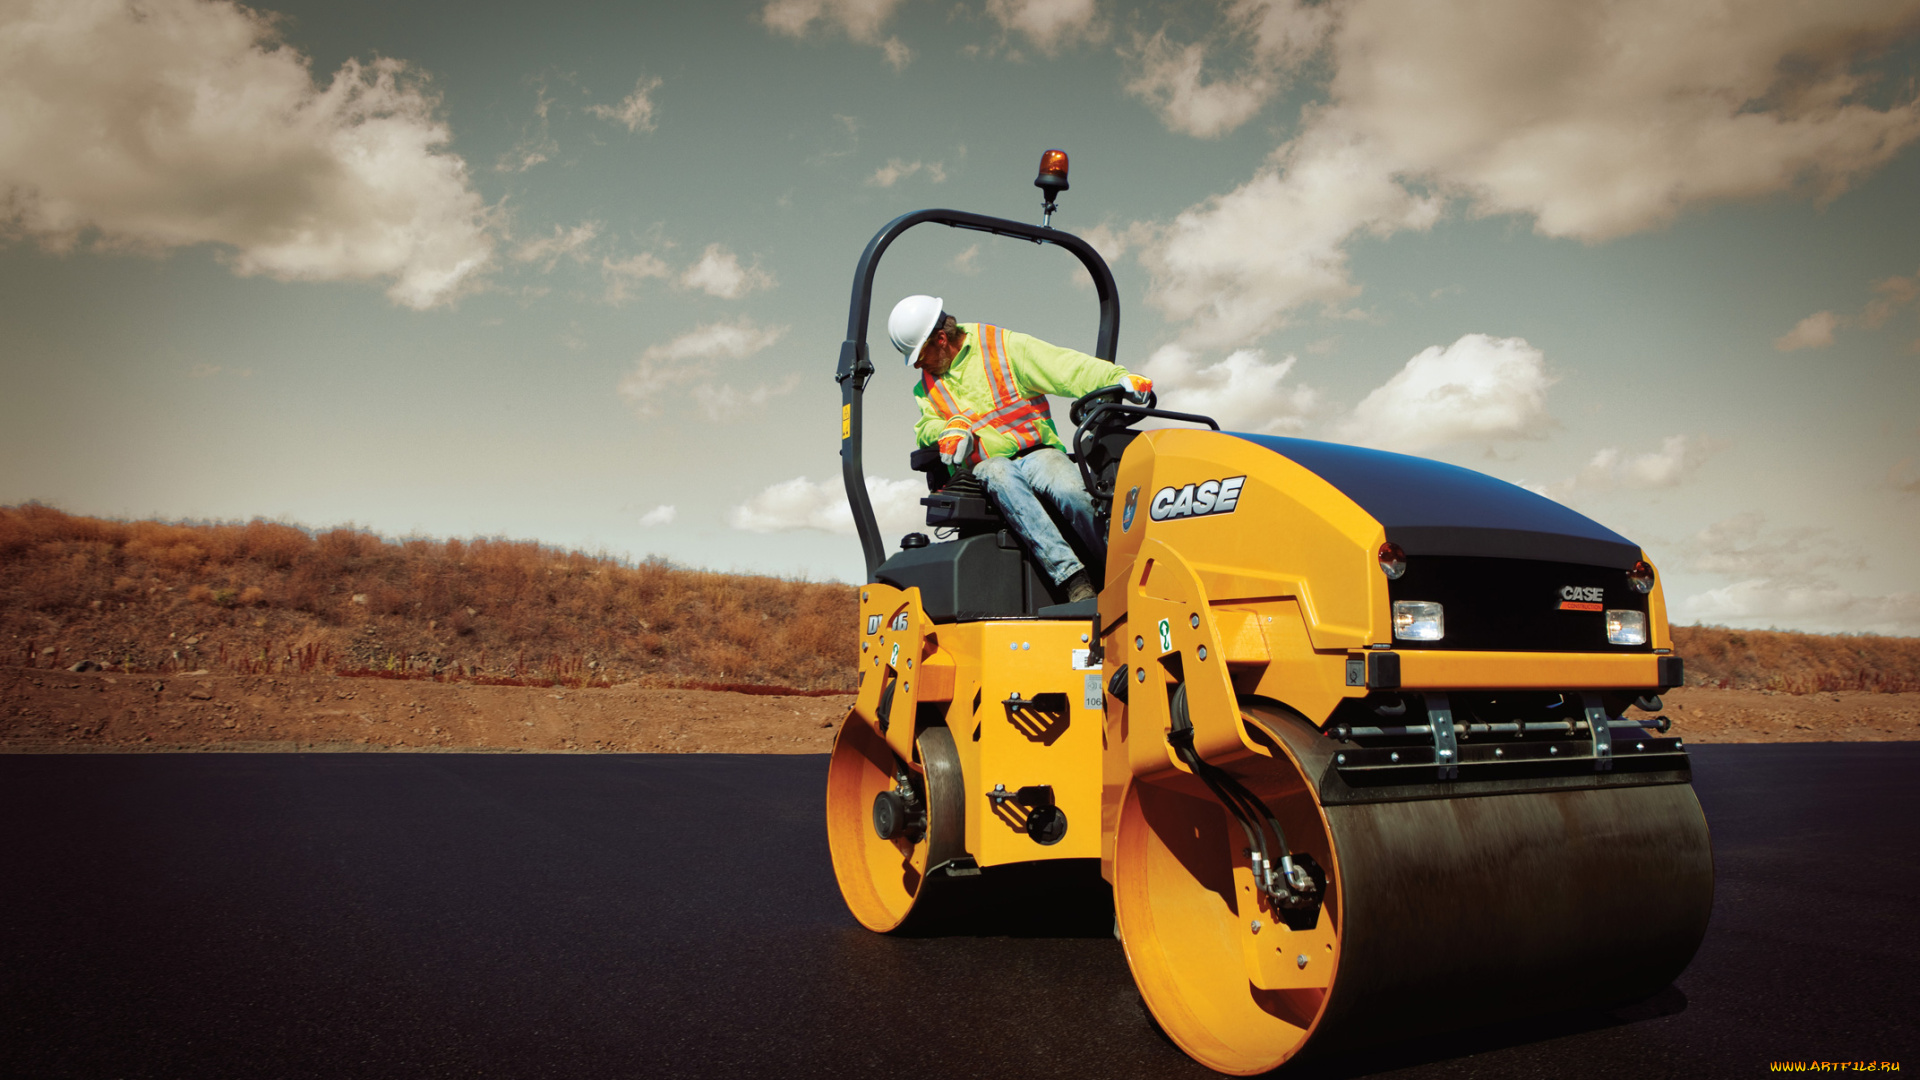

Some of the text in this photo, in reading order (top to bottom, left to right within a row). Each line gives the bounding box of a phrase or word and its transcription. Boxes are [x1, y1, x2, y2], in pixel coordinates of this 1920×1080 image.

[1150, 475, 1247, 522] CASE
[1561, 585, 1603, 602] CASE
[1567, 602, 1602, 610] CONSTRUCTION
[1086, 697, 1102, 706] 106
